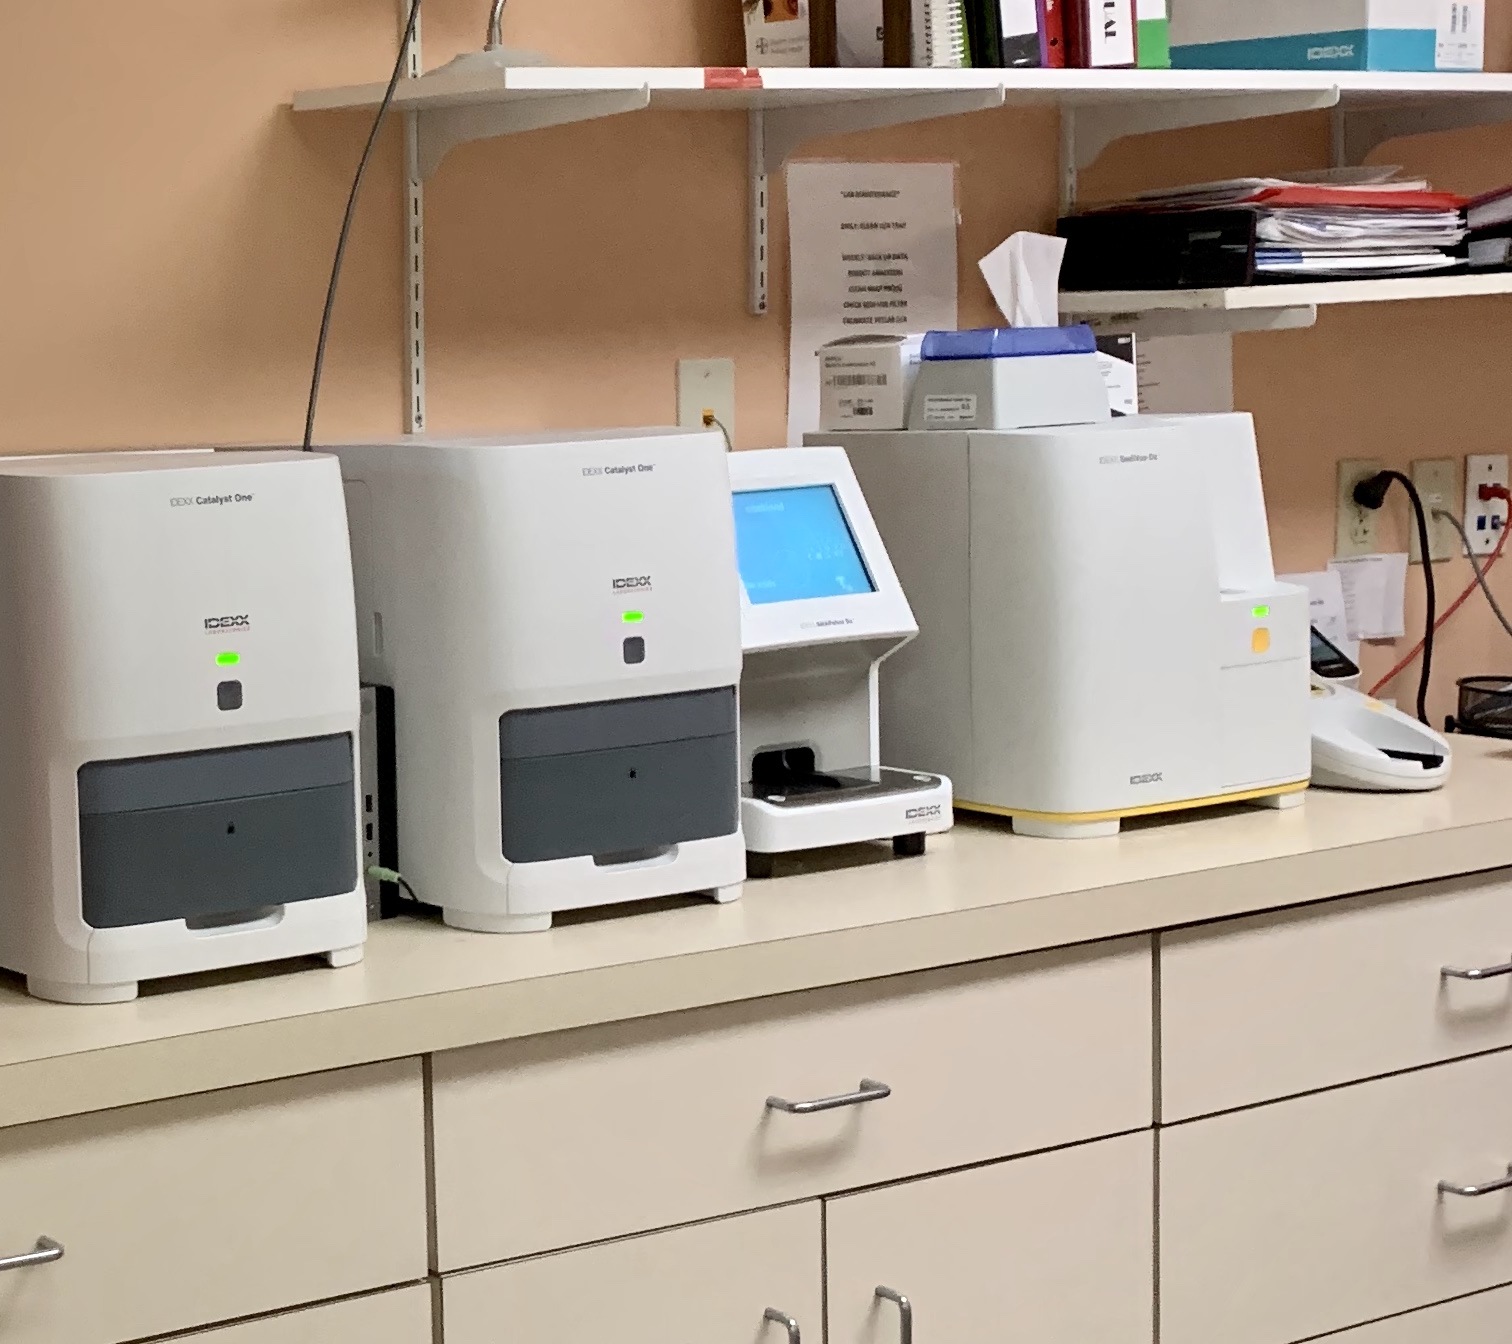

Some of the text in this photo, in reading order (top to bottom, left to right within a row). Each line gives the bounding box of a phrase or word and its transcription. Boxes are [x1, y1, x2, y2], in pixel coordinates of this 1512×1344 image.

[604, 465, 636, 475] Catalyst
[195, 494, 233, 505] Catalyst
[612, 576, 652, 589] IDEXX
[204, 614, 250, 629] IDEXX
[905, 804, 941, 819] IDEXX
